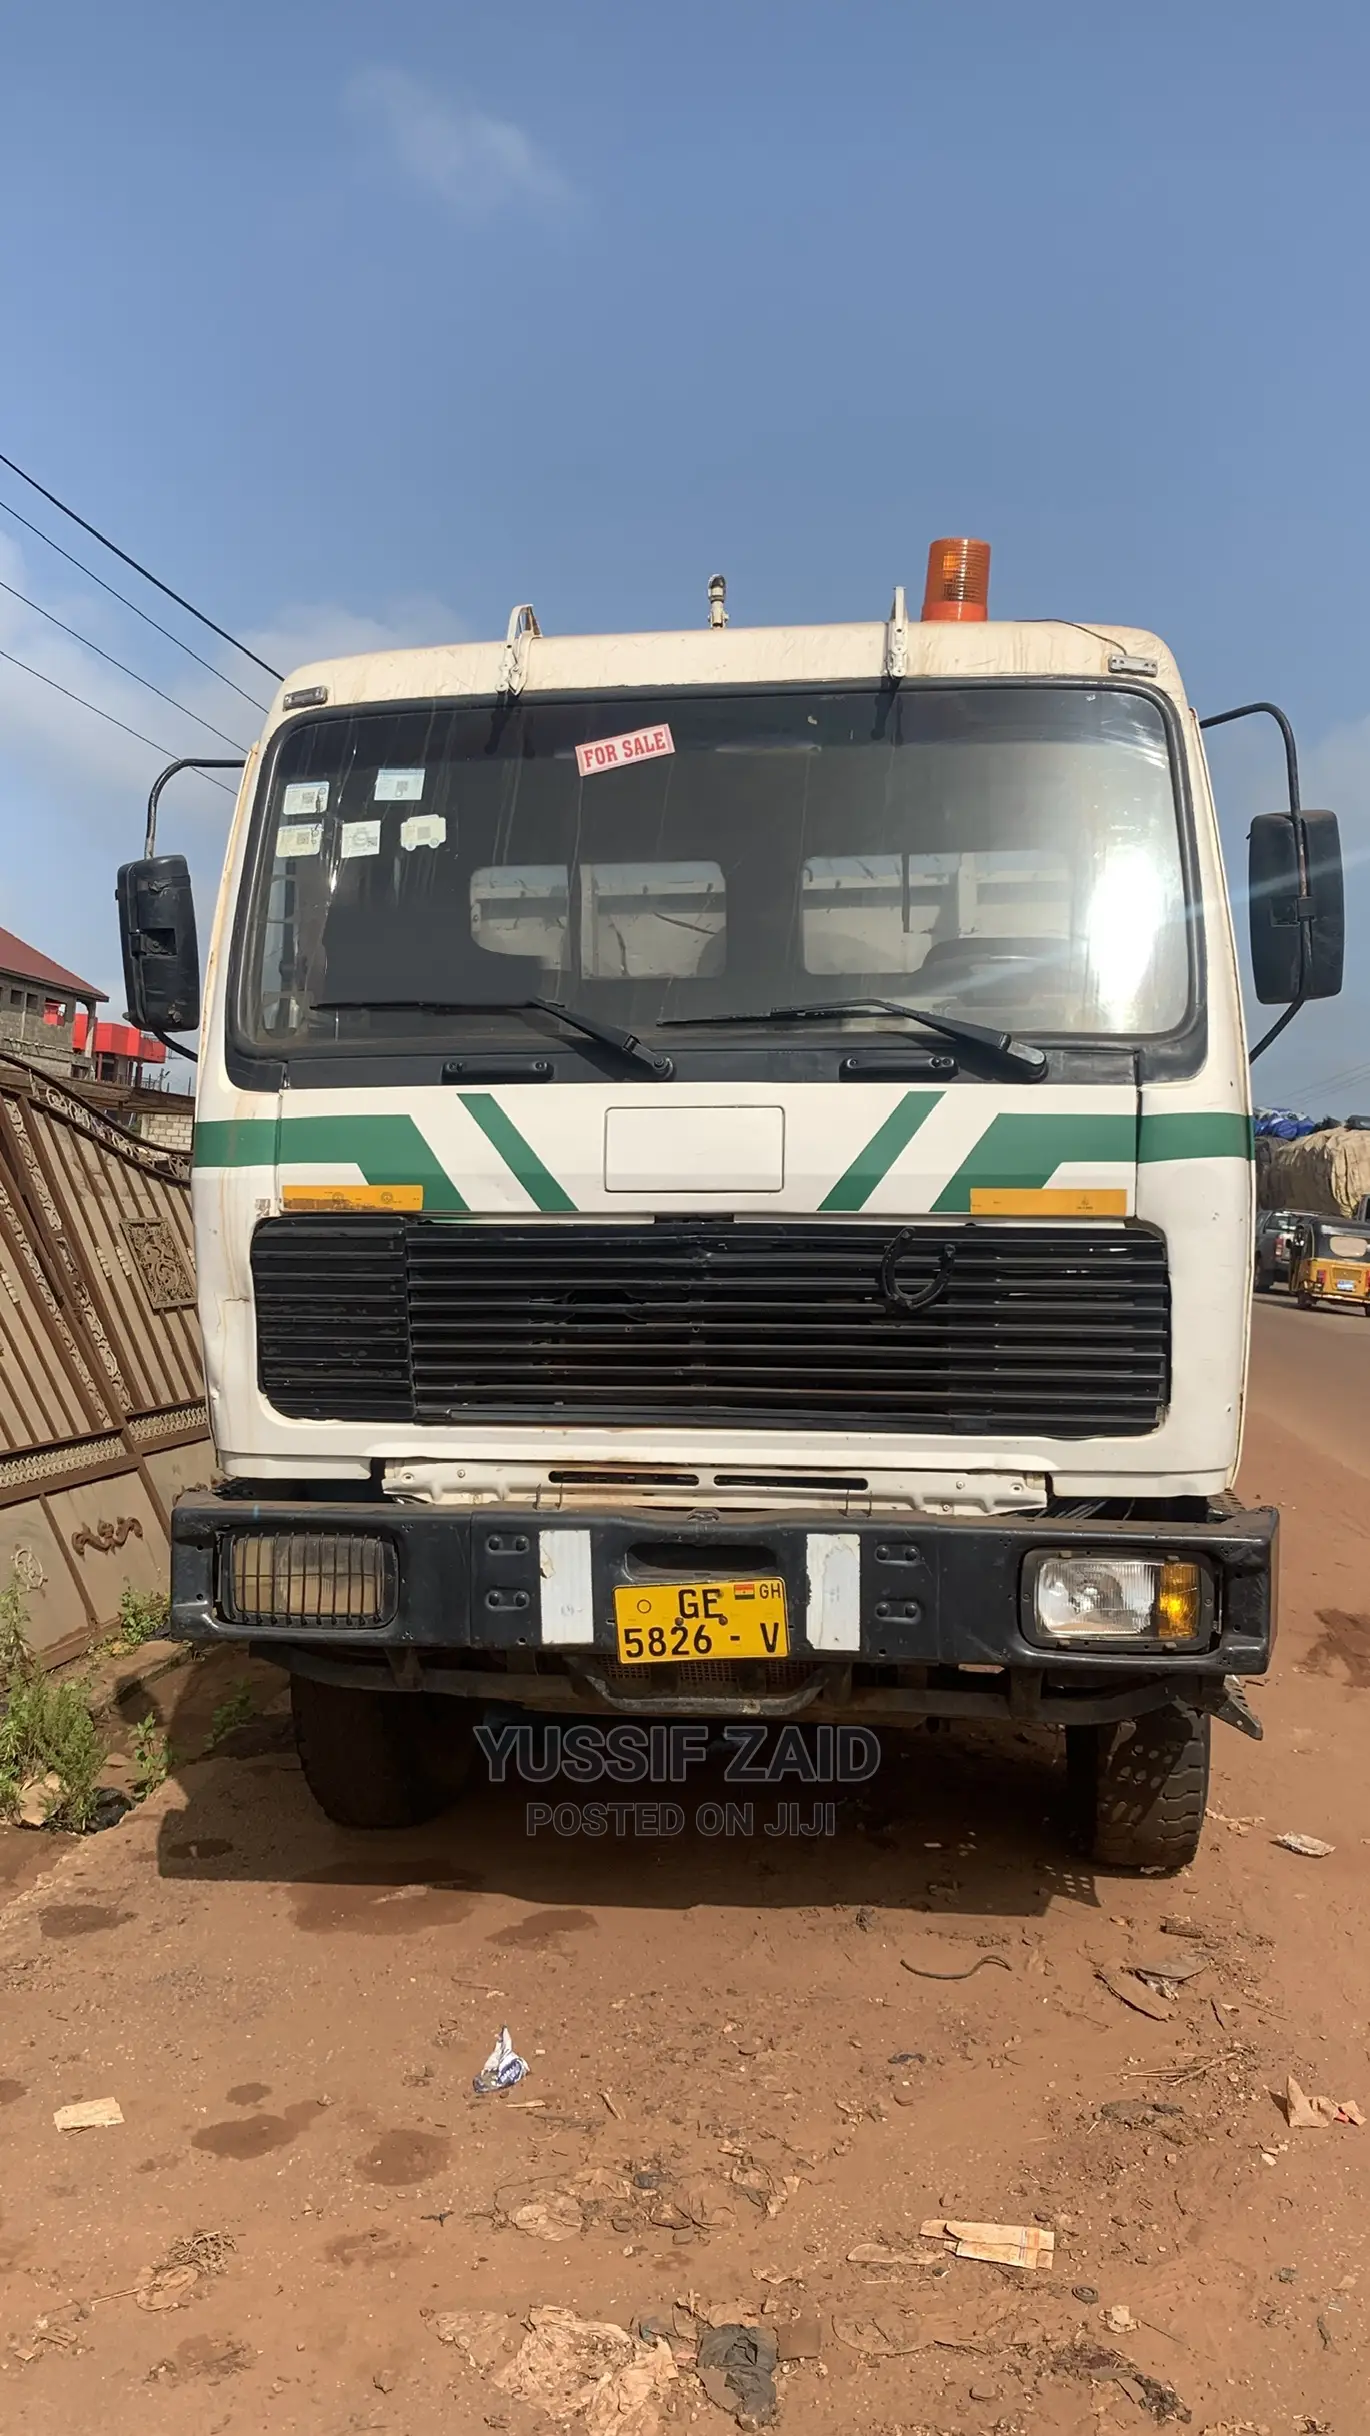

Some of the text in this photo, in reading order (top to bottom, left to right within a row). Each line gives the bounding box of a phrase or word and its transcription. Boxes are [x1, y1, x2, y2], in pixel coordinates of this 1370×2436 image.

[583, 732, 666, 768] FOR SALE
[678, 1589, 724, 1619] GE
[759, 1583, 781, 1599] GH
[624, 1625, 712, 1658] 5826
[760, 1623, 779, 1653] V
